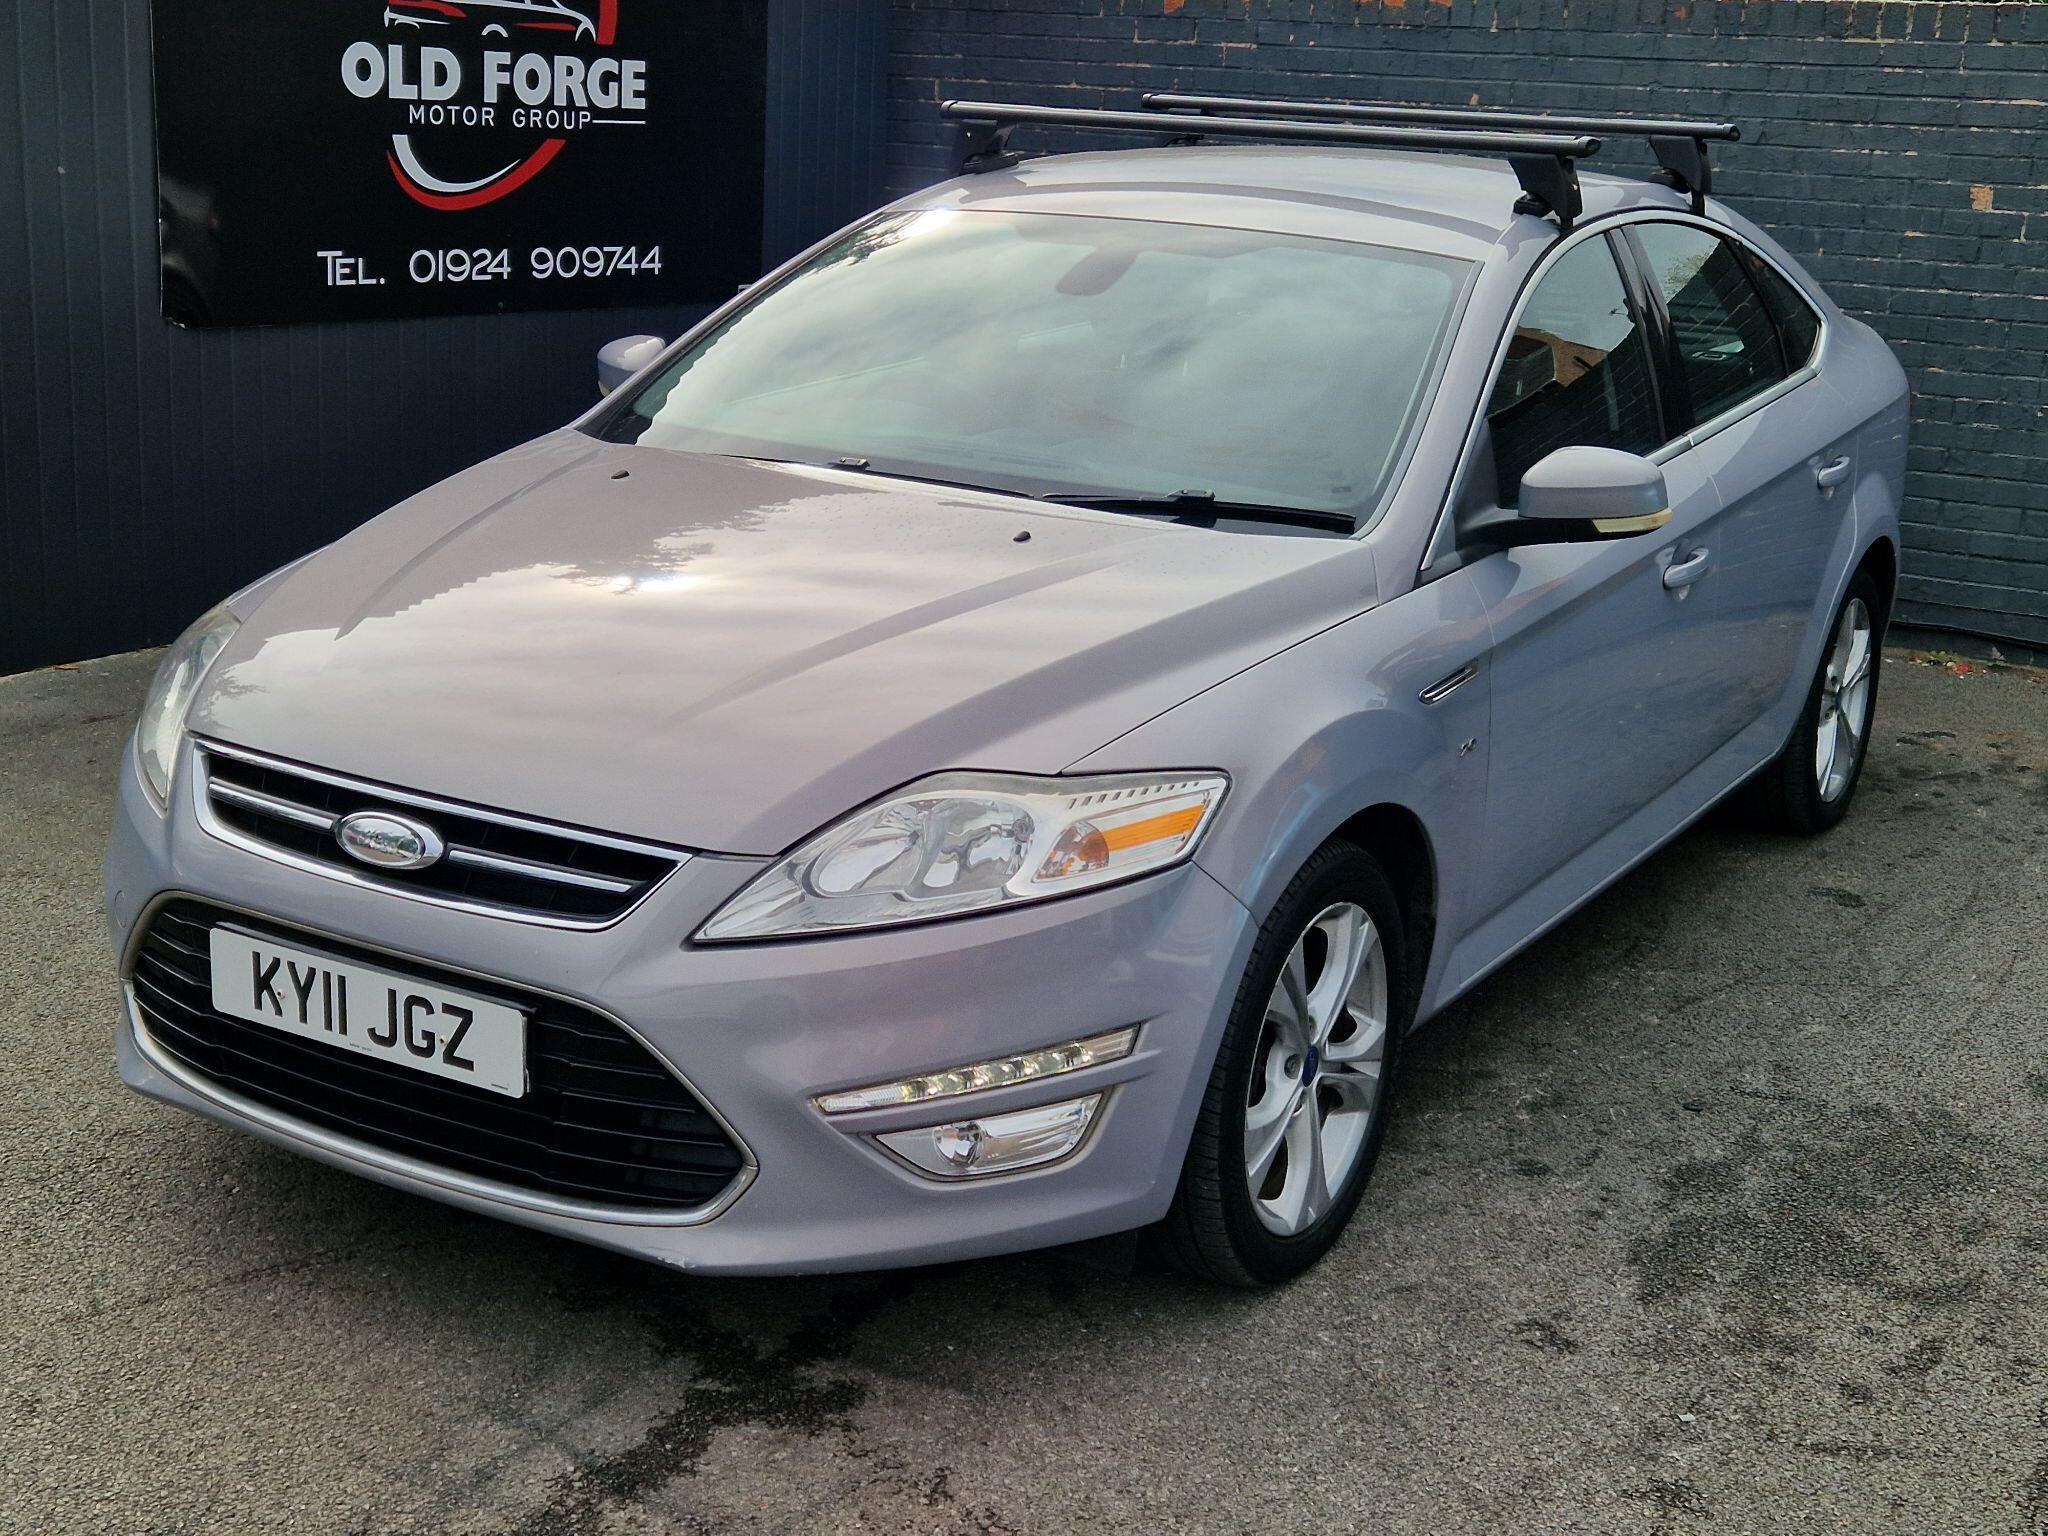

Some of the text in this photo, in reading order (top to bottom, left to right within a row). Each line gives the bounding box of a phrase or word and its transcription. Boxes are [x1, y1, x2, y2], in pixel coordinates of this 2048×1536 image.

[341, 41, 646, 110] OLD FORGE
[409, 104, 591, 130] MOTOR GROUP
[317, 246, 662, 286] TEL. 01924 909744
[252, 950, 475, 1072] KY11 JGZ
